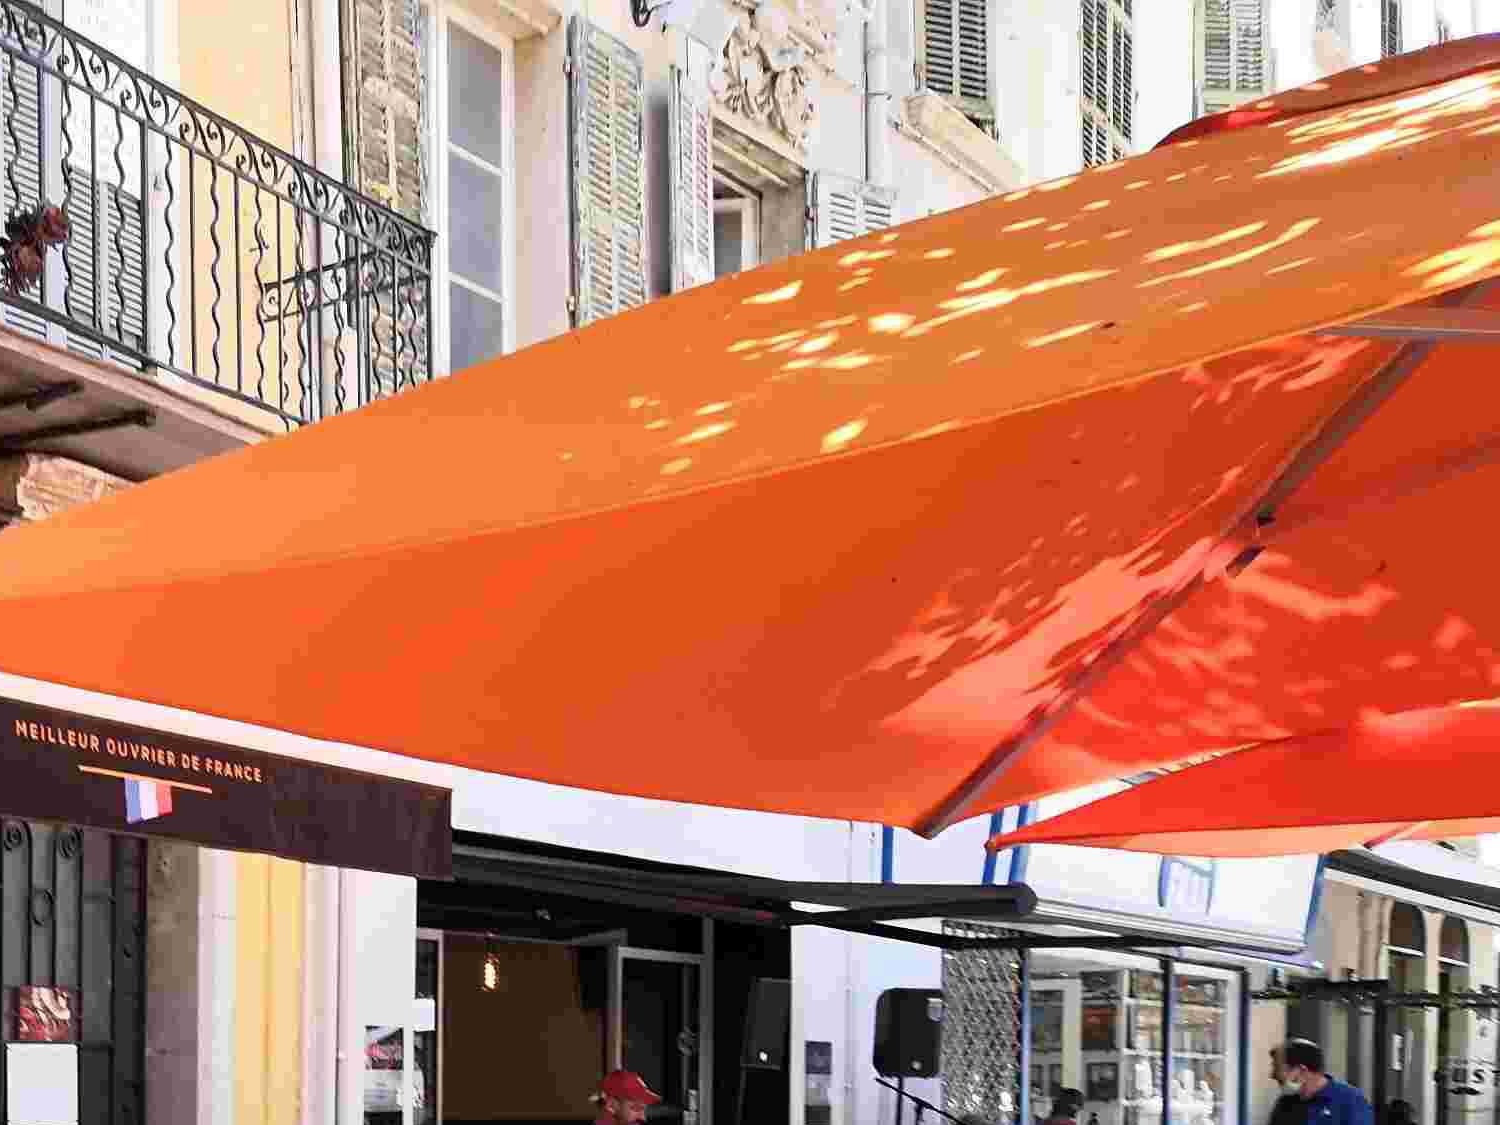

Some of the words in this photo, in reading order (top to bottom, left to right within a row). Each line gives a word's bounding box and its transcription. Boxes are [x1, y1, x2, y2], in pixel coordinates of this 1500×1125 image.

[14, 719, 100, 752] MEILLEUR
[106, 738, 175, 768] OUVRIER
[181, 752, 200, 771] DE
[205, 757, 263, 783] FRANCE
